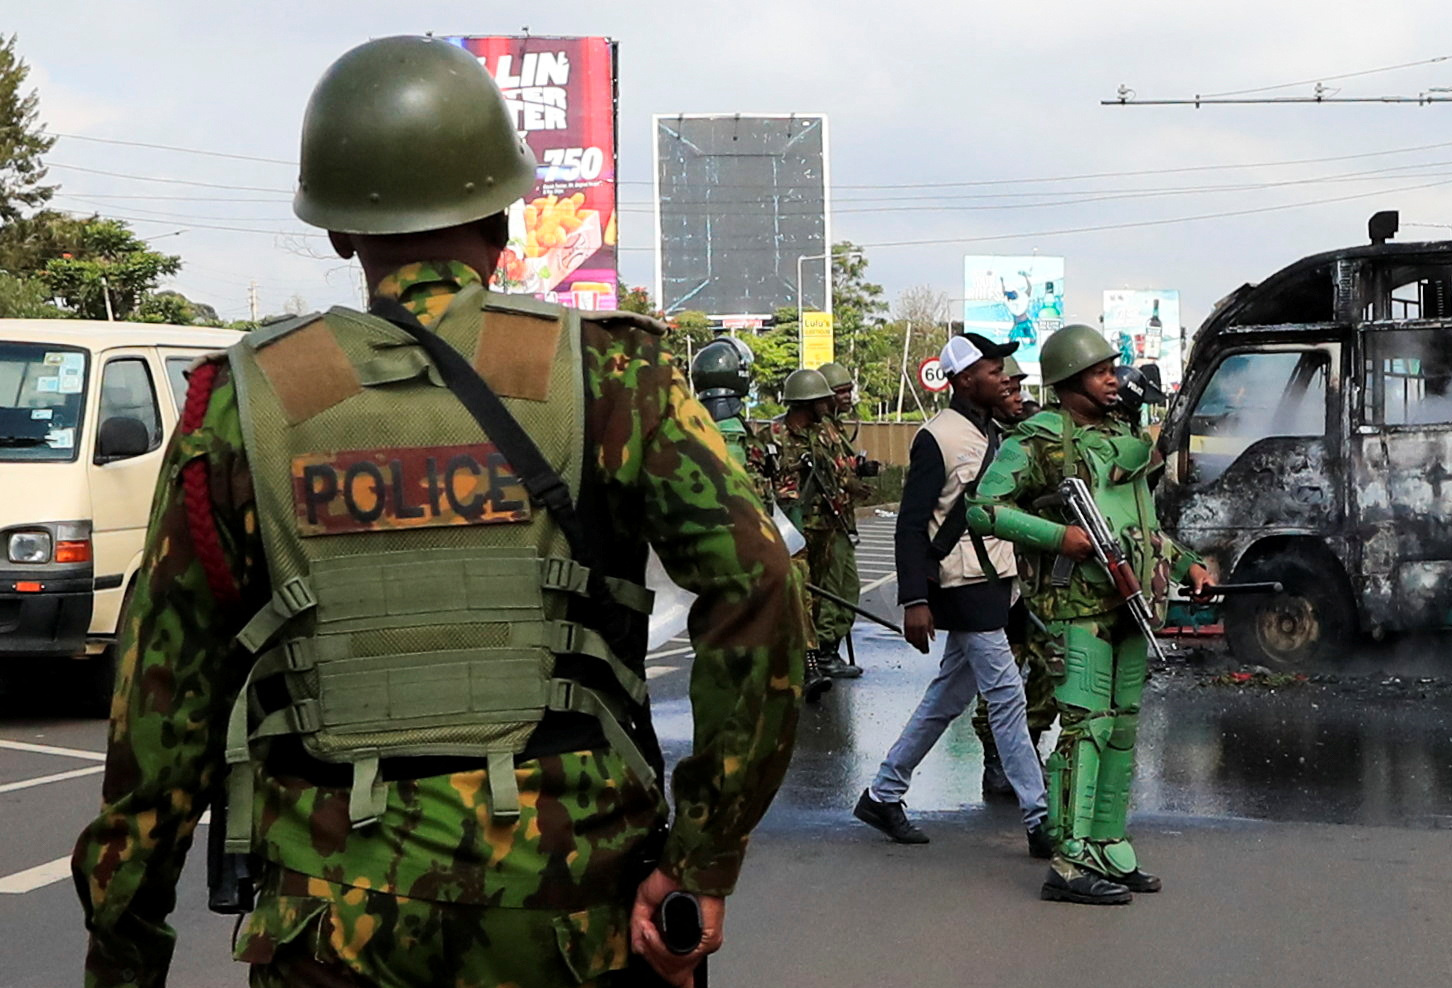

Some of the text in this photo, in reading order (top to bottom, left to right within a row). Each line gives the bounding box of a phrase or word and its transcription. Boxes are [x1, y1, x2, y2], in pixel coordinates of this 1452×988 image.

[478, 51, 569, 89] LIN
[543, 147, 603, 182] 750
[925, 367, 945, 381] 60
[304, 453, 524, 525] POLICE
